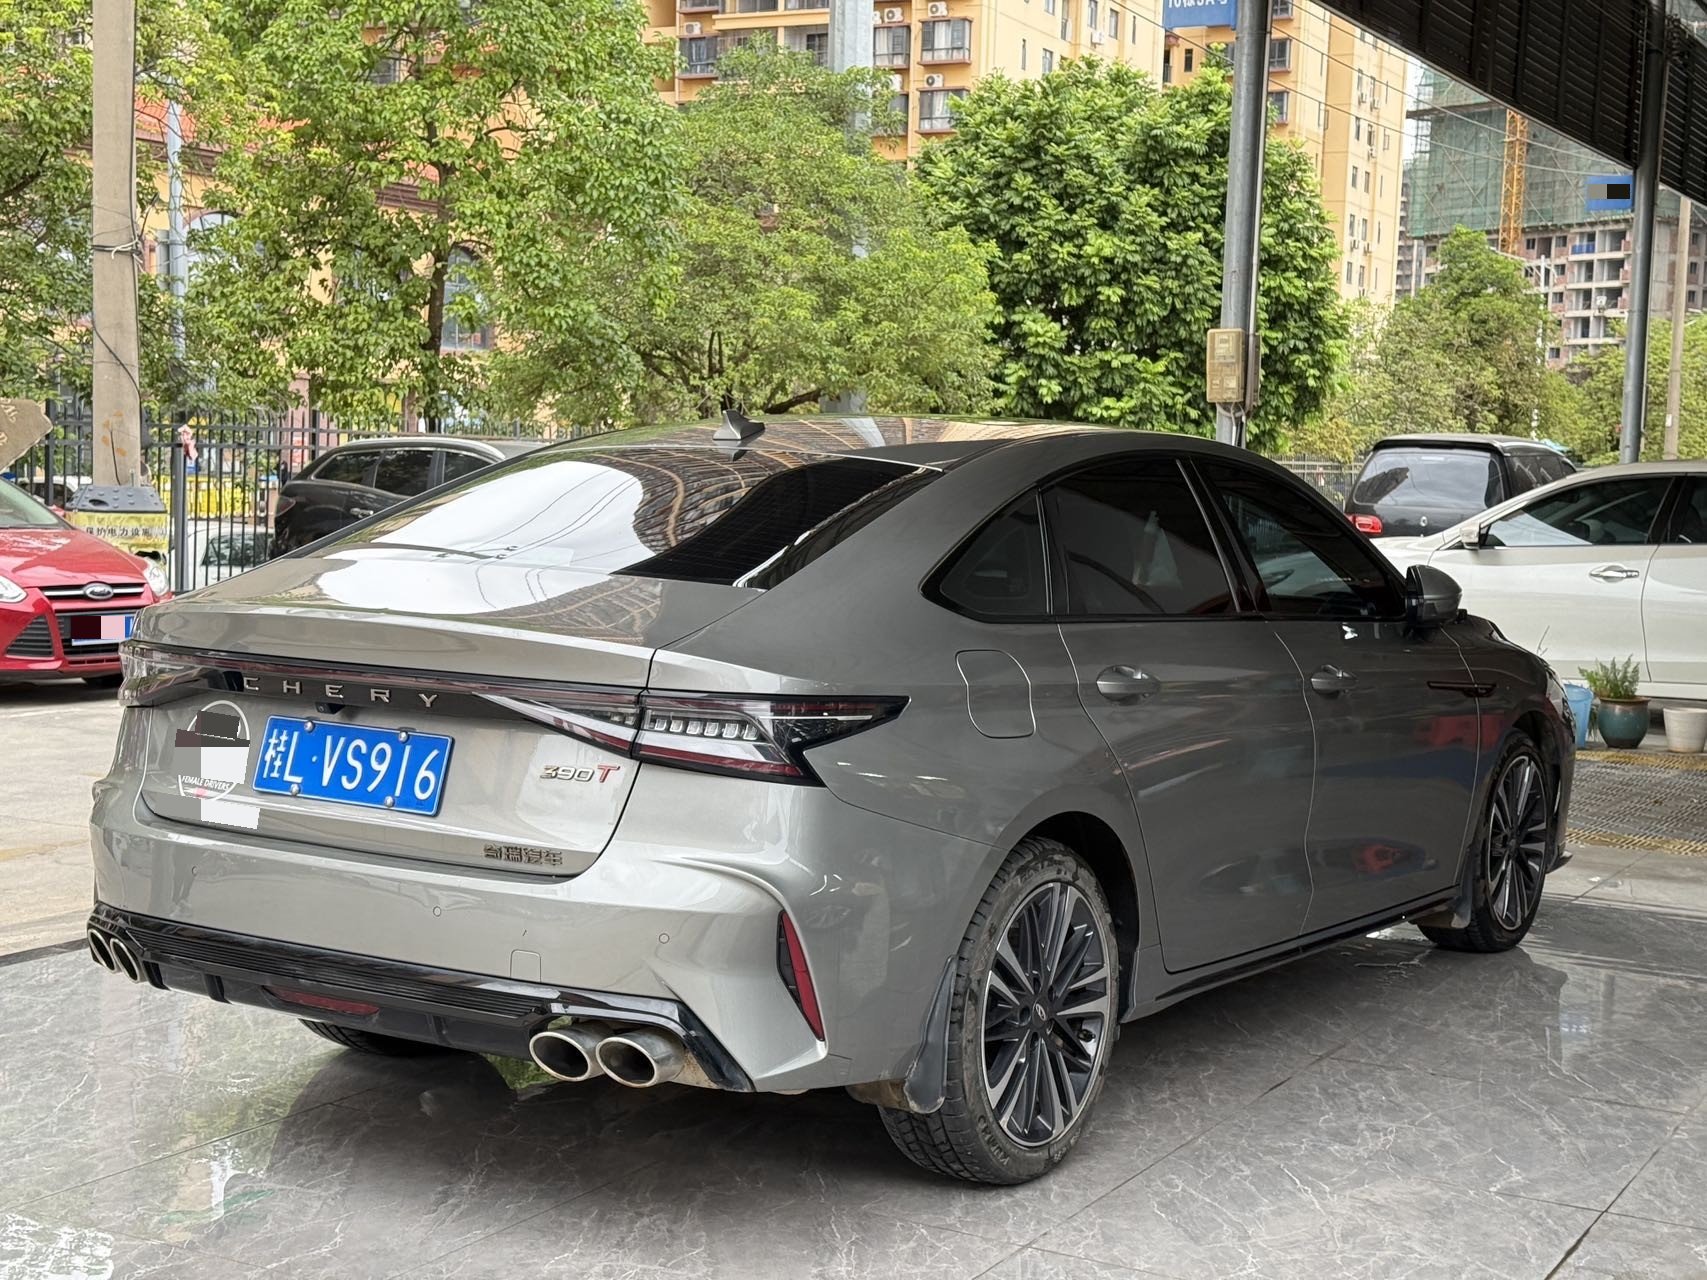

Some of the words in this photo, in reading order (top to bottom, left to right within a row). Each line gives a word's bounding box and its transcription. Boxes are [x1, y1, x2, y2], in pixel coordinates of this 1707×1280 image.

[243, 676, 438, 708] CHERY
[181, 775, 205, 786] FEMALE
[204, 778, 231, 791] DRIVERS
[540, 764, 621, 783] 390T
[483, 843, 563, 866] 奇瑞汽车
